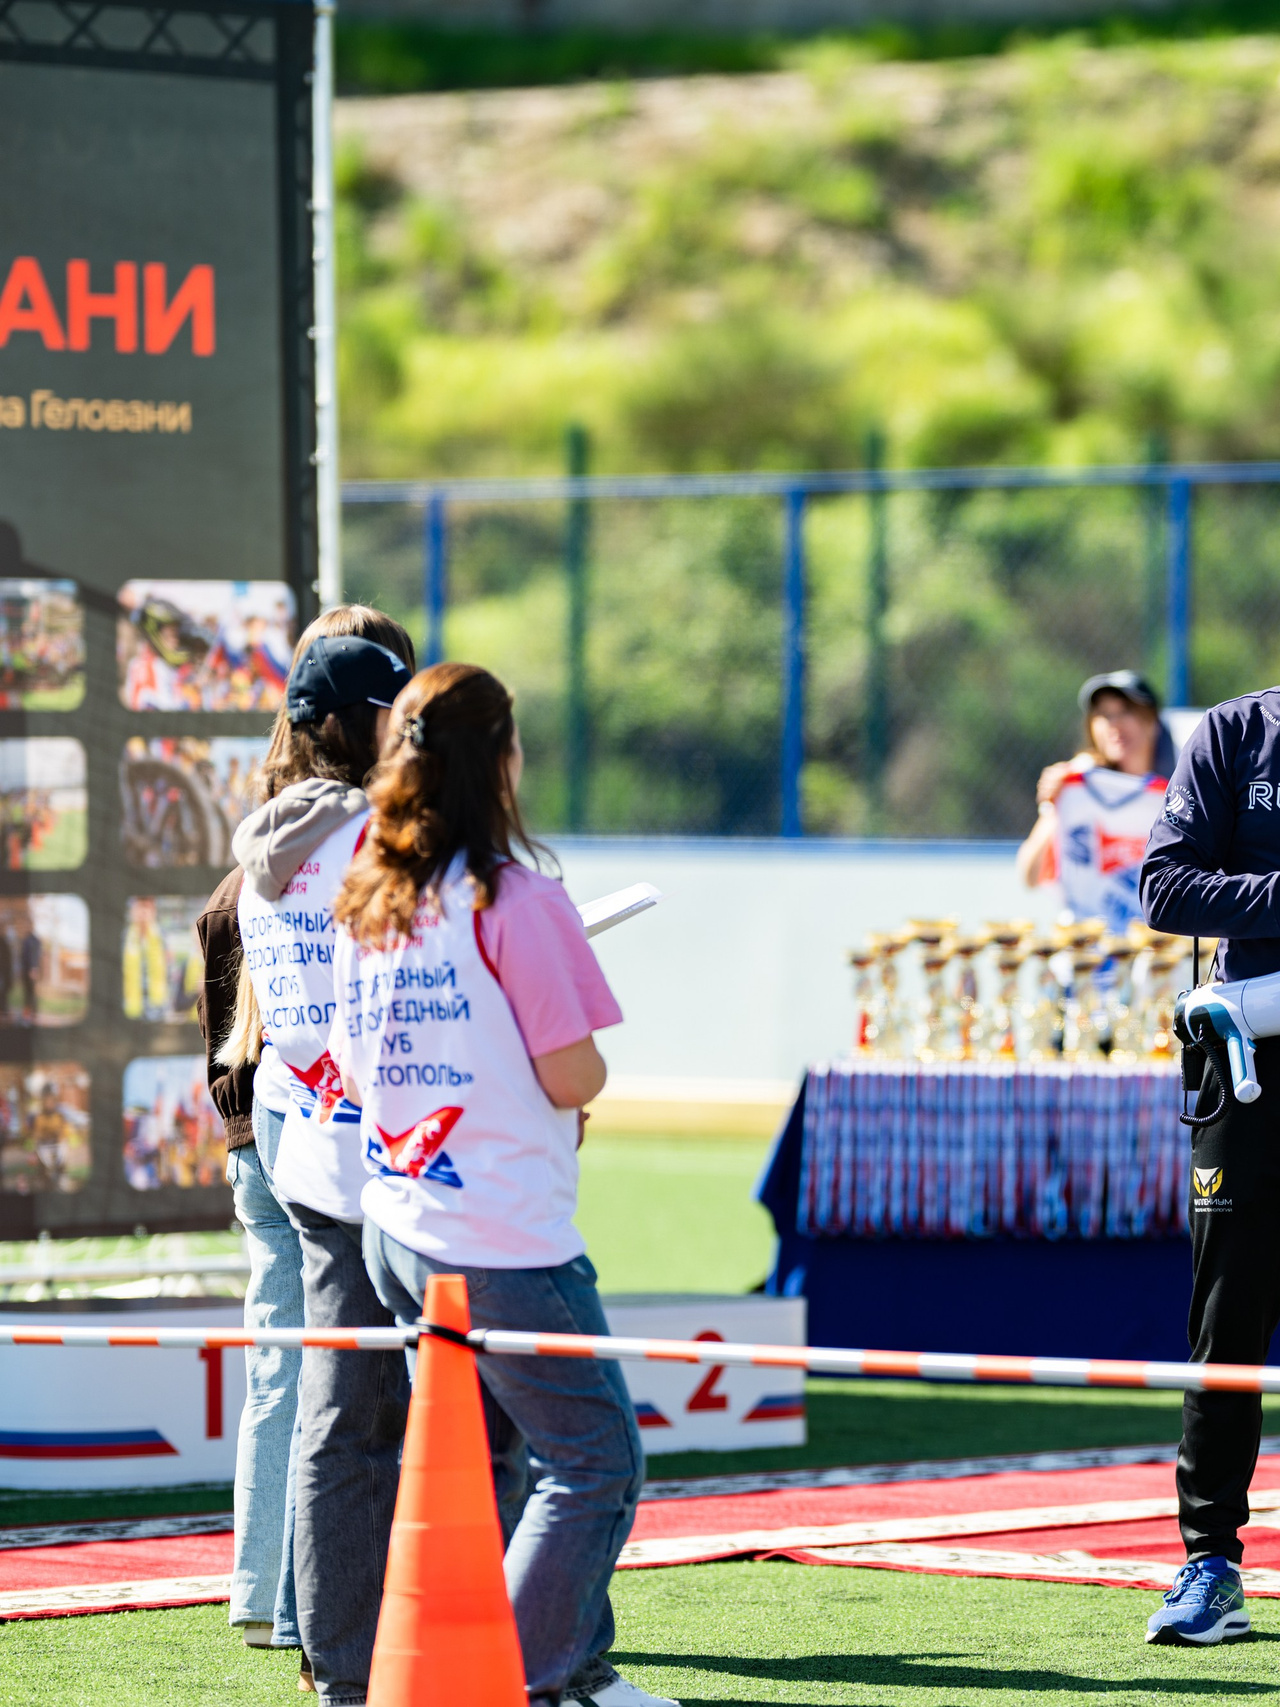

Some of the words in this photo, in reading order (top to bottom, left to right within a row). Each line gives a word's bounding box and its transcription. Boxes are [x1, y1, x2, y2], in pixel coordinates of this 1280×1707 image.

[0, 256, 215, 357] АНИ
[31, 389, 193, 435] Геловани
[1258, 705, 1280, 727] RUSSIAN
[687, 1330, 730, 1413] 2
